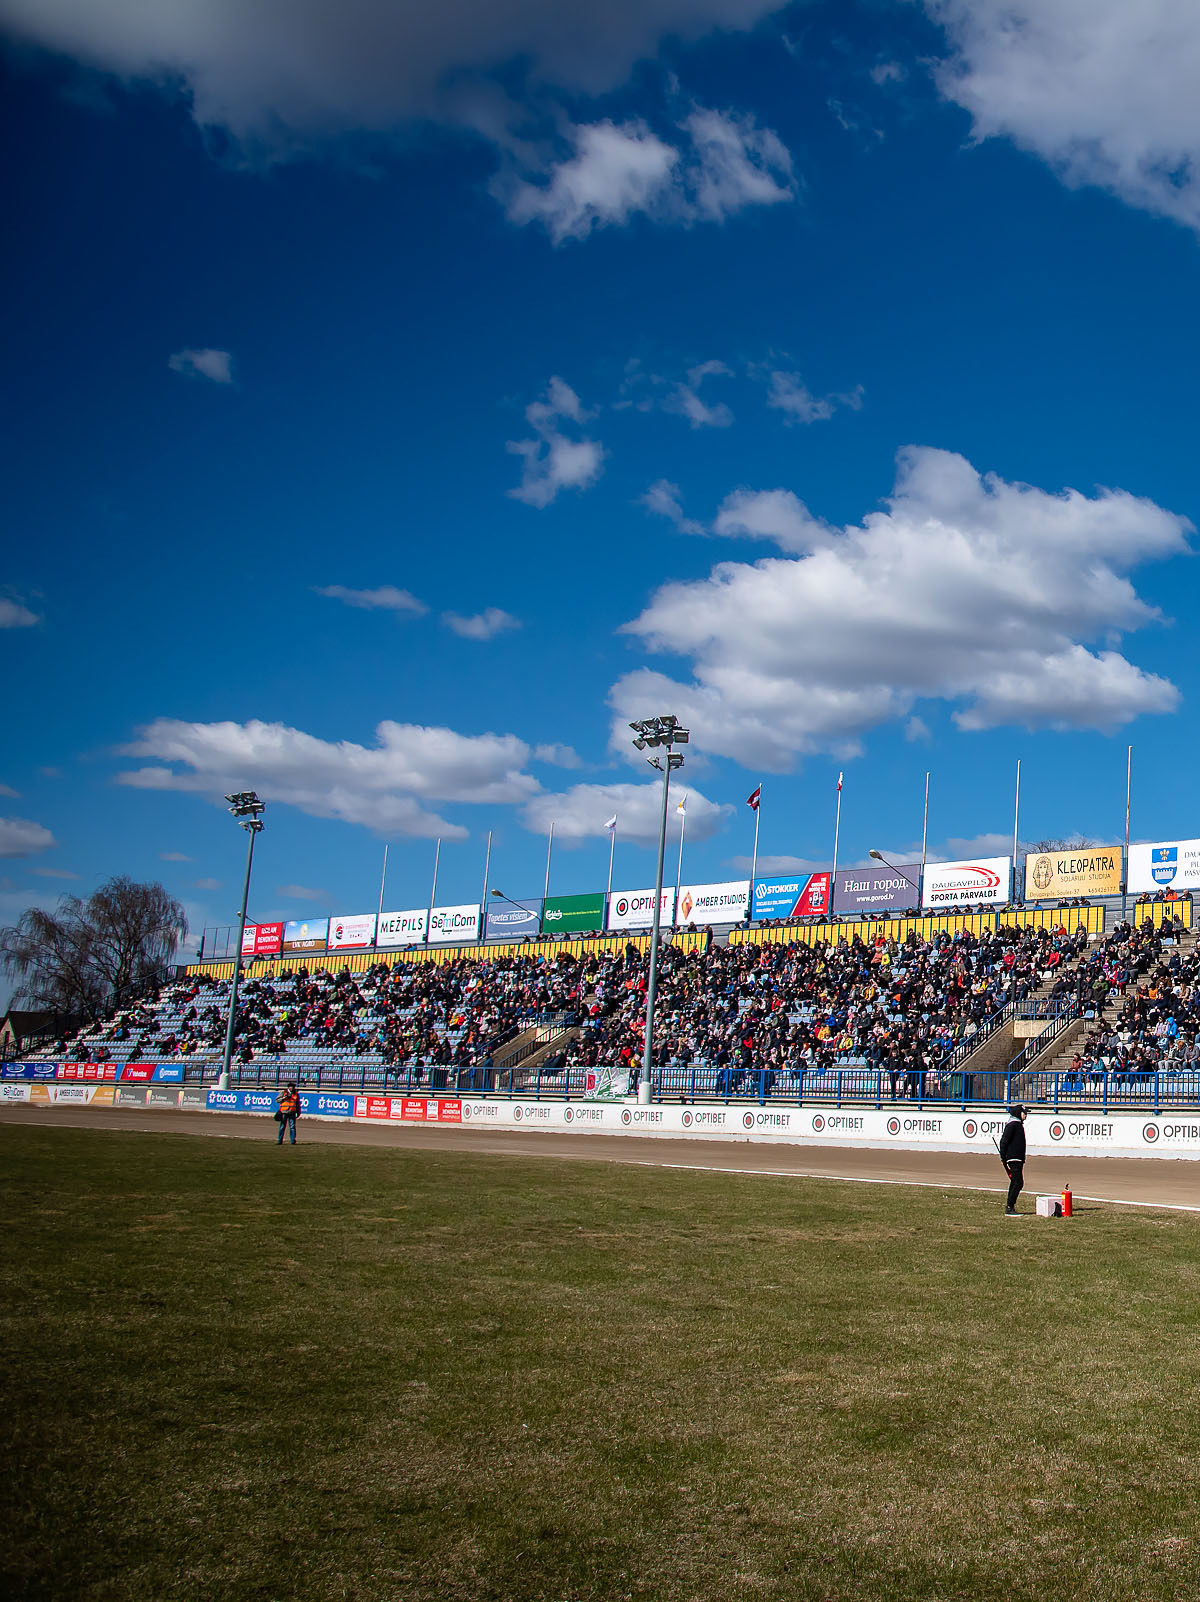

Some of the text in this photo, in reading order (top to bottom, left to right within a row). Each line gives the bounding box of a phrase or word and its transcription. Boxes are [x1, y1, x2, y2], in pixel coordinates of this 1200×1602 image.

[1057, 856, 1114, 875] KLEOPATRA
[766, 884, 799, 895] STOKKER
[844, 880, 870, 893] Наш
[932, 878, 987, 889] DAUGAVPILS
[695, 897, 718, 907] AMBER
[719, 893, 747, 905] STUDIOS
[930, 893, 958, 902] SPORTA
[380, 916, 424, 934] MEŽPILS
[431, 913, 476, 929] SemiCom
[216, 1093, 237, 1103] trodo
[251, 1095, 272, 1105] trodo
[326, 1098, 349, 1109] trodo
[473, 1105, 499, 1117] OPTIBET
[525, 1108, 551, 1119] OPTIBET
[576, 1109, 604, 1120] OPTIBET
[633, 1111, 664, 1122] OPTIBET
[695, 1112, 727, 1124] OPTIBET
[756, 1113, 791, 1126] OPTIBET
[827, 1116, 864, 1129] OPTIBET
[903, 1119, 943, 1132] OPTIBET
[1068, 1123, 1114, 1137] OPTIBET
